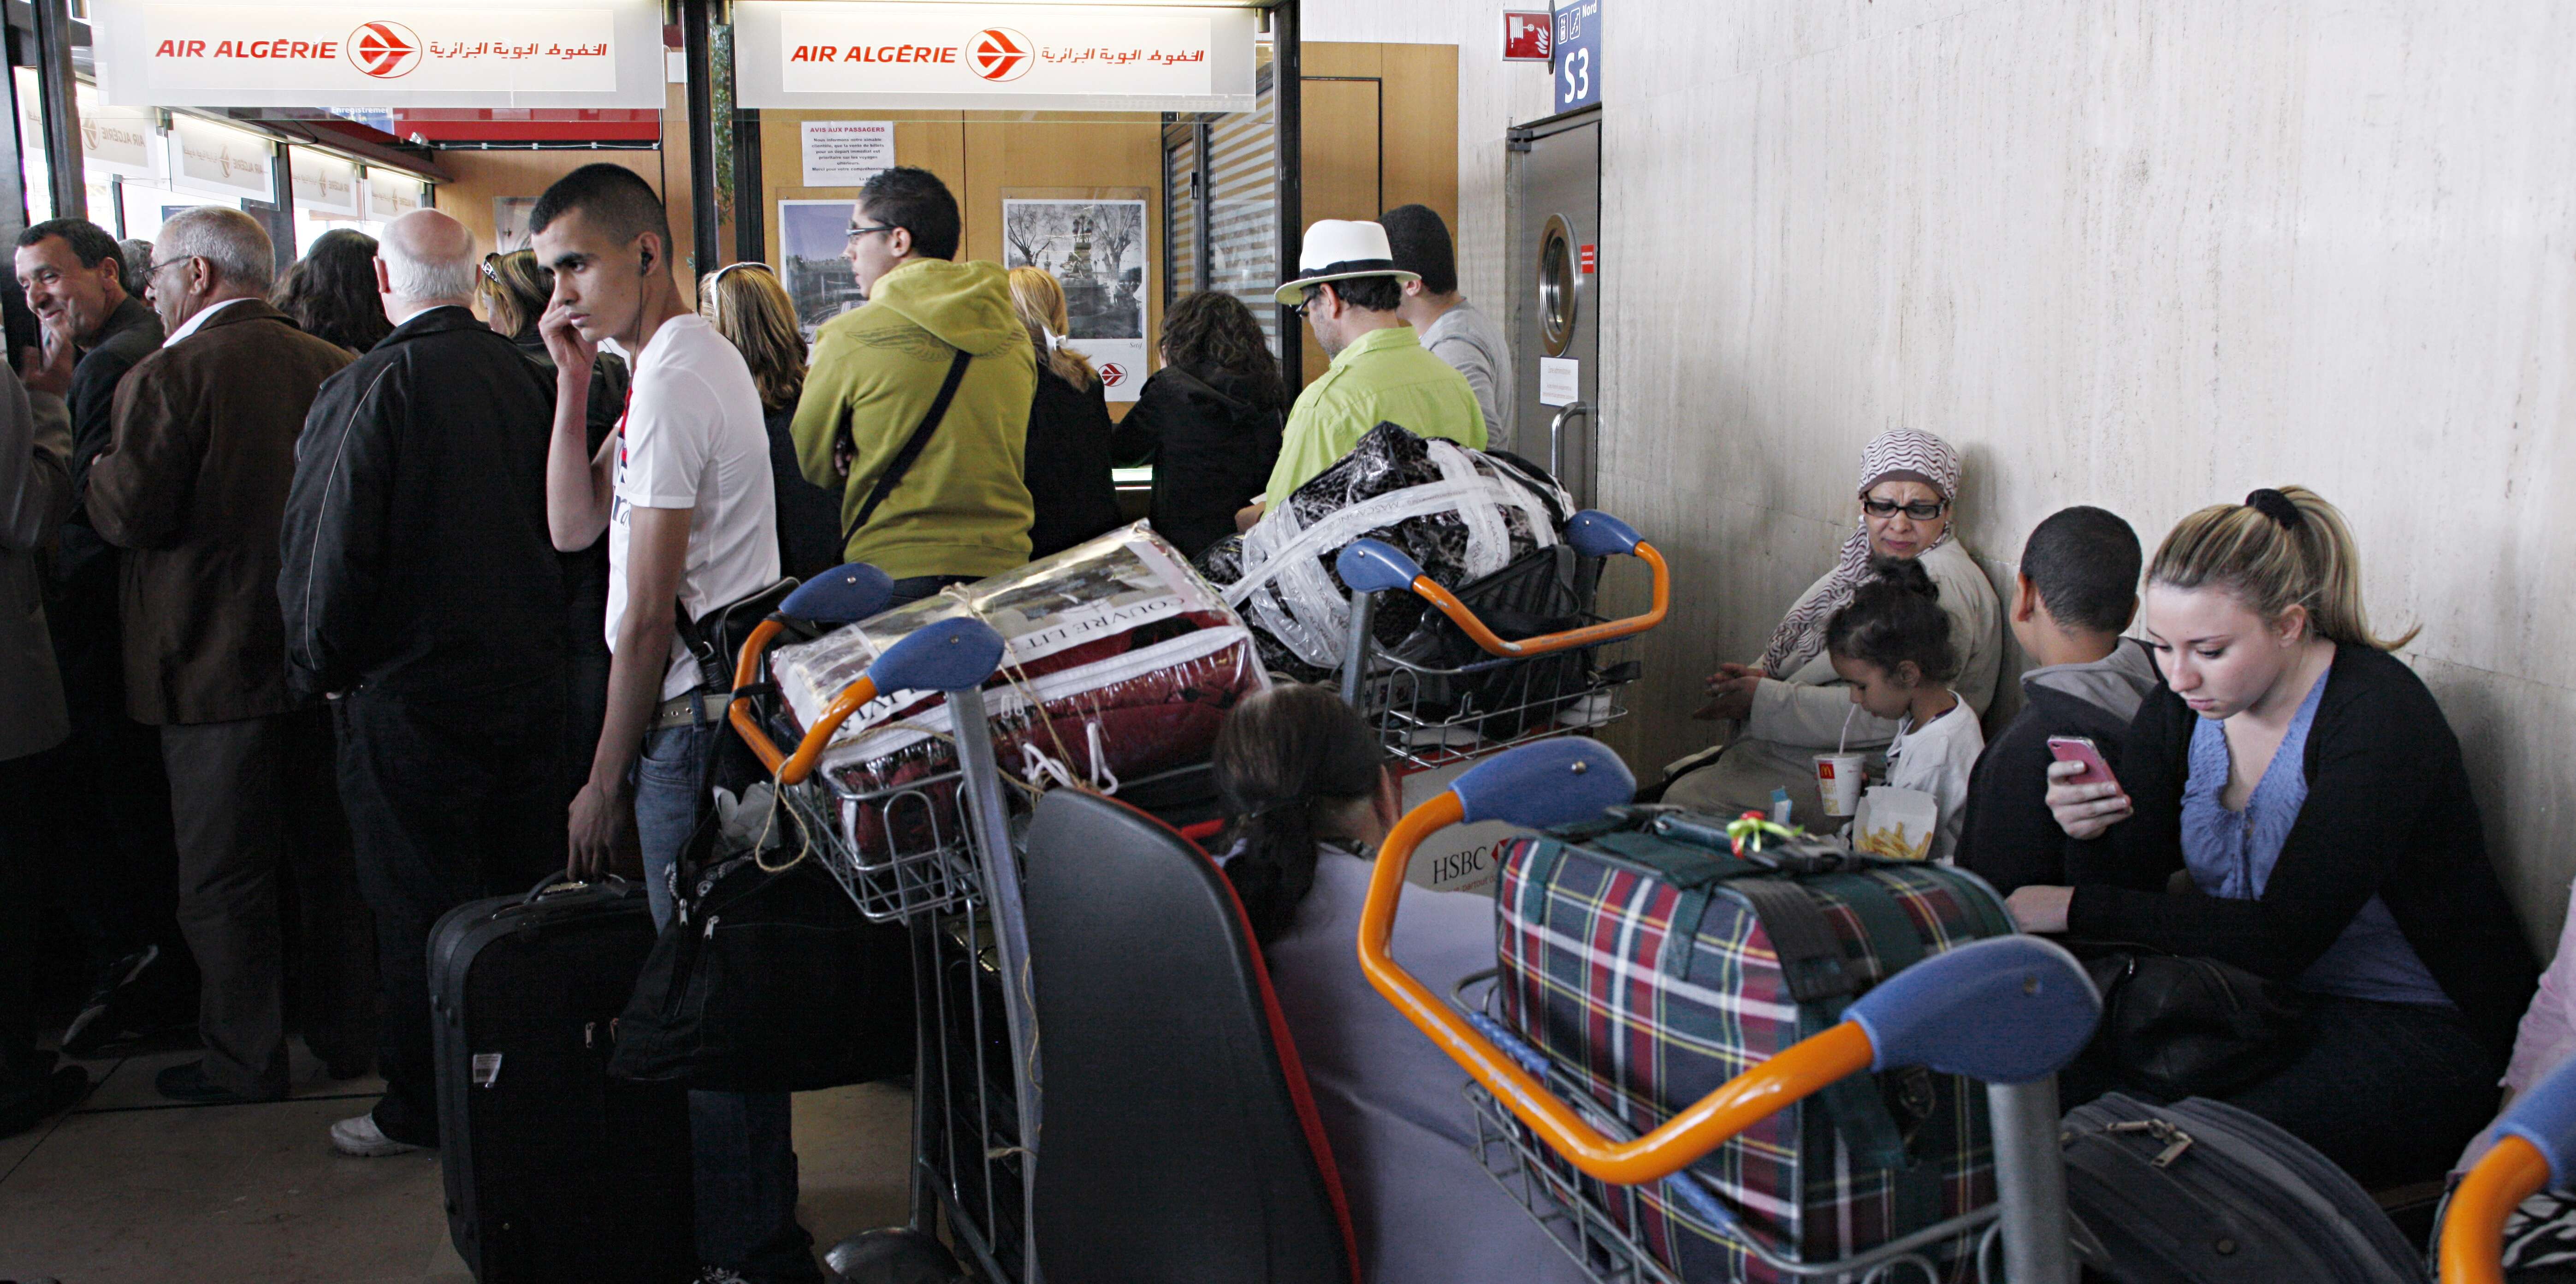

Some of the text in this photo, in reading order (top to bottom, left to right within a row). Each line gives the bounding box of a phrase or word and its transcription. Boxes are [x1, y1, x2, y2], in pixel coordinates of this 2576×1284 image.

[1582, 0, 1597, 18] Nord
[155, 39, 338, 59] AIR ALGÉRIE
[493, 42, 539, 59] الجوية
[545, 43, 607, 60] الخطوط
[790, 44, 958, 63] AIR ALGÉRIE
[1100, 48, 1142, 64] الجوية
[1147, 49, 1204, 65] الخطوط
[1564, 48, 1589, 104] S3
[1076, 598, 1185, 633] COUVRE
[1026, 628, 1067, 650] LIT
[1433, 846, 1487, 885] HSBC
